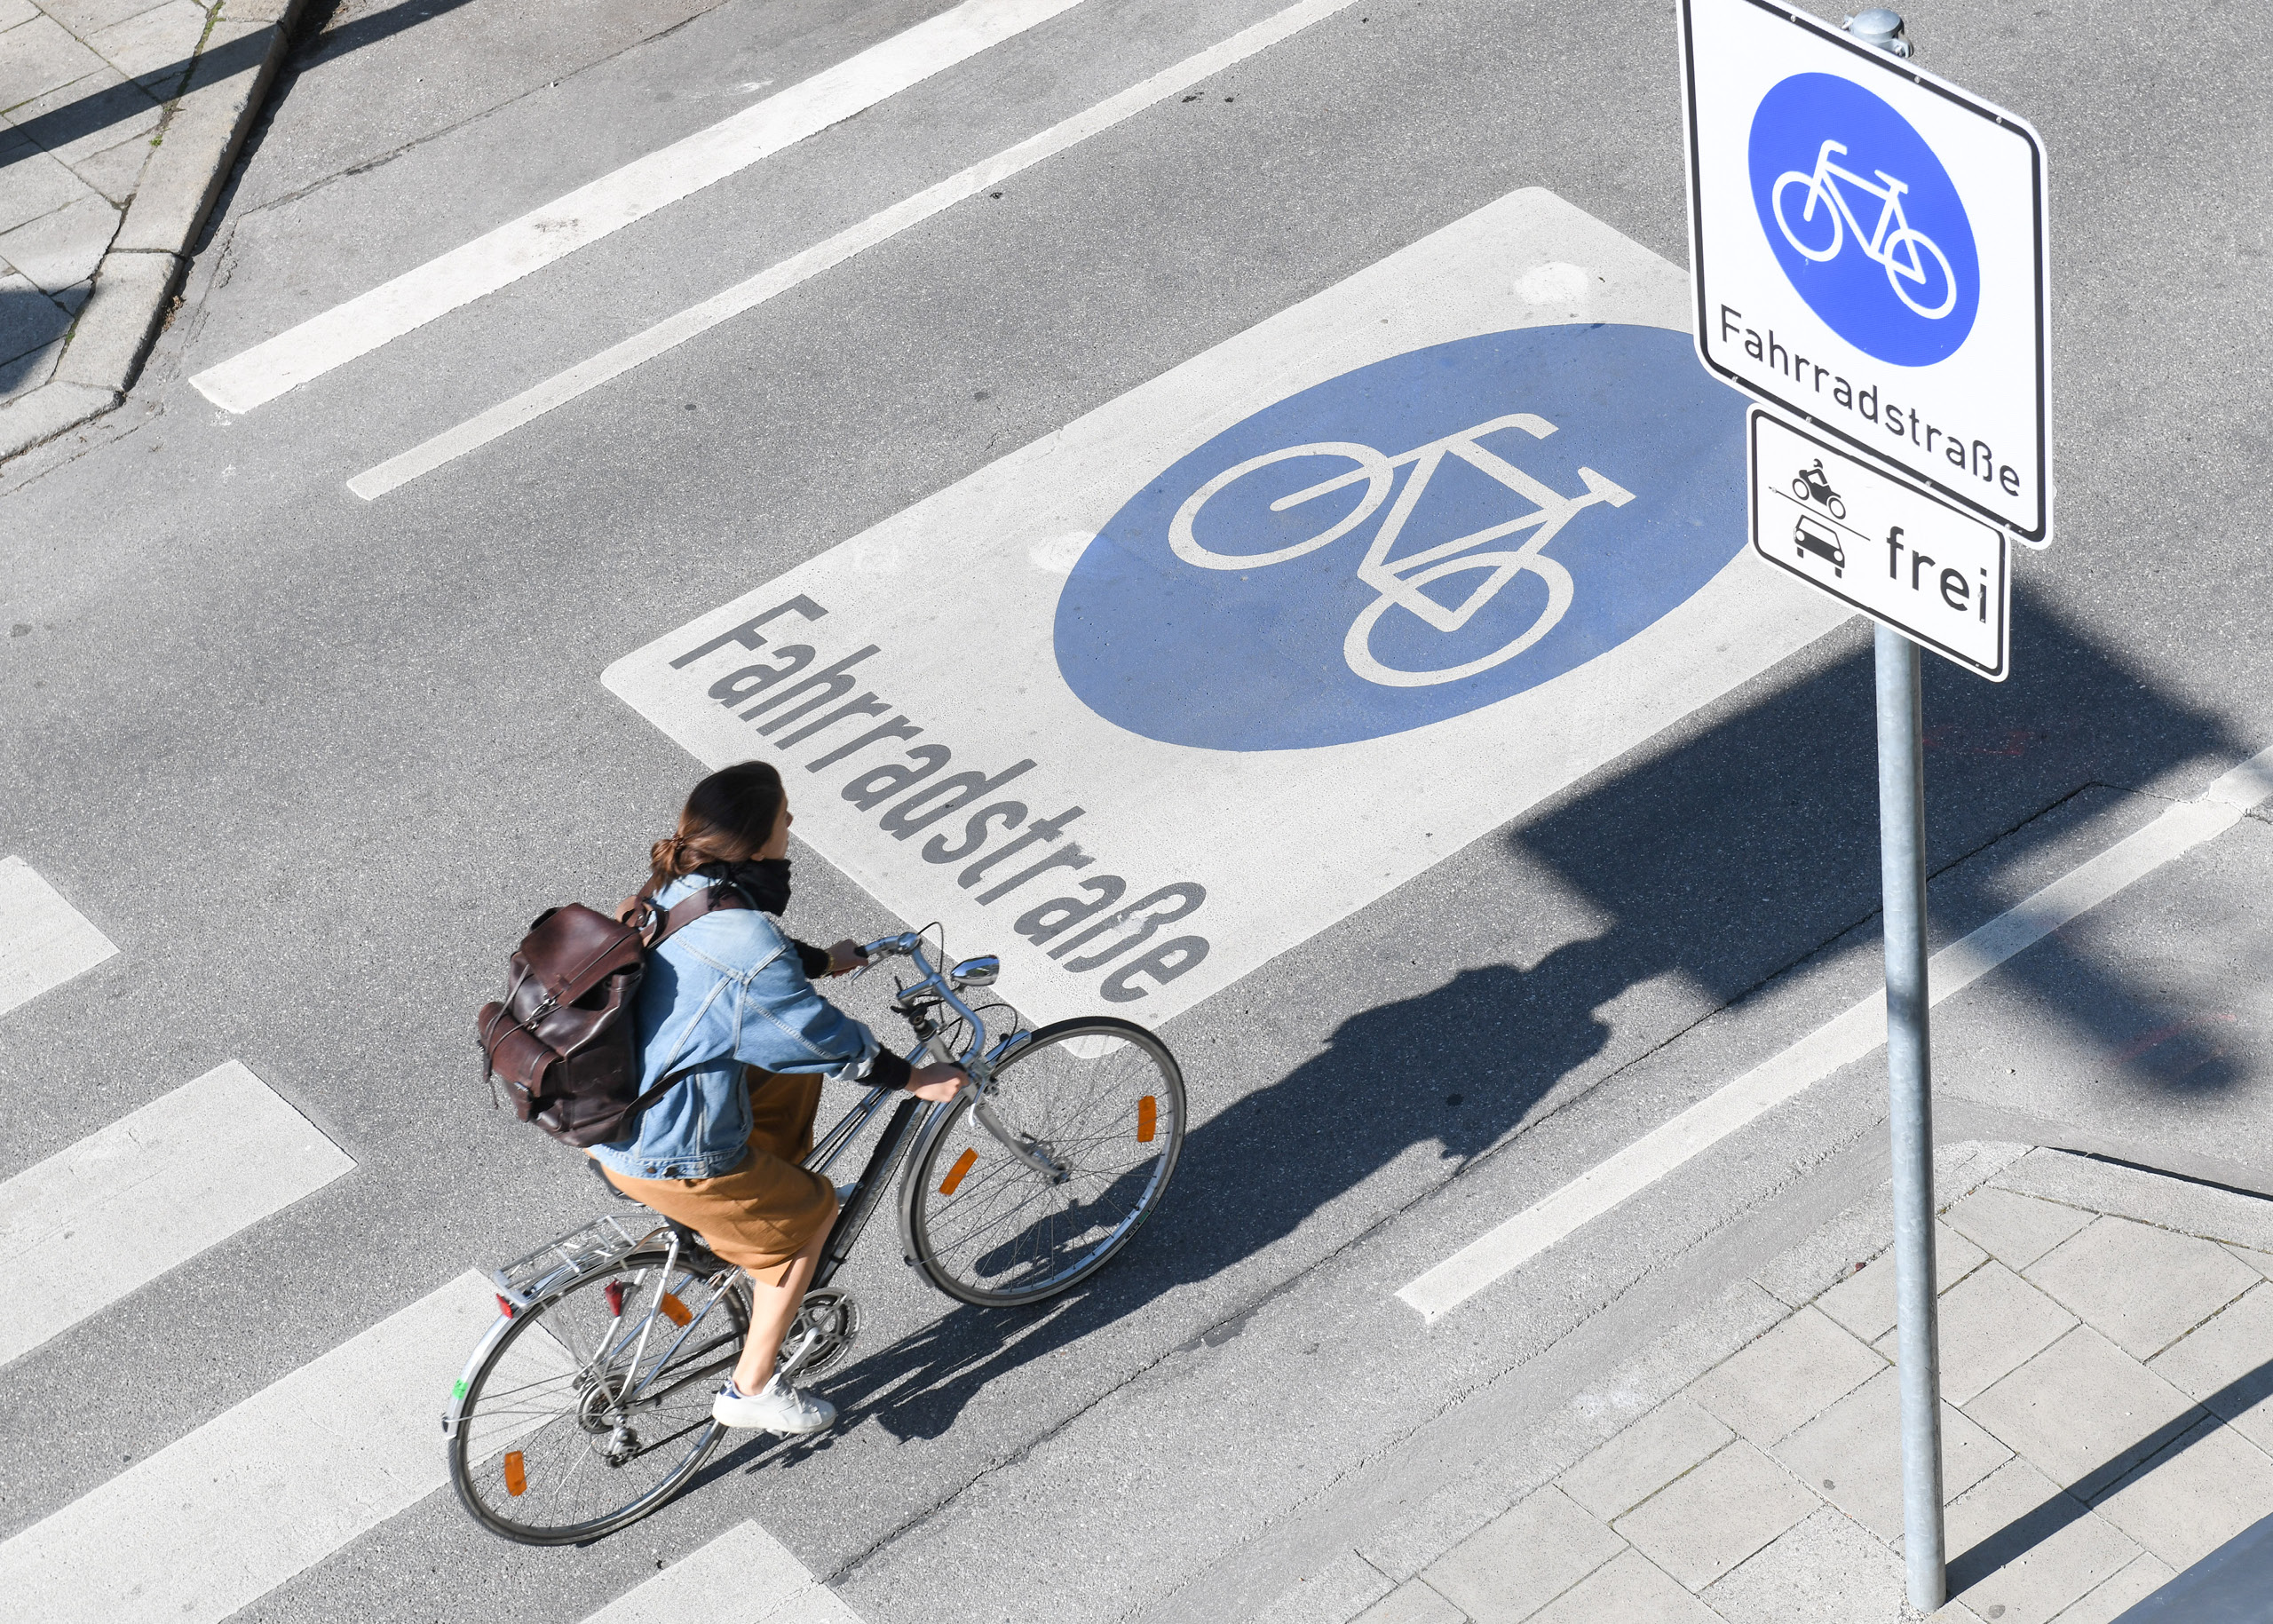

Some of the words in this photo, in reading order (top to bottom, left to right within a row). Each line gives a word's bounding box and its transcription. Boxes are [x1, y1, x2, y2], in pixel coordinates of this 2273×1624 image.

[1721, 304, 2020, 497] Fahrradstraße
[1886, 526, 1987, 624] frei
[669, 593, 1210, 1003] Fahrradstraße
